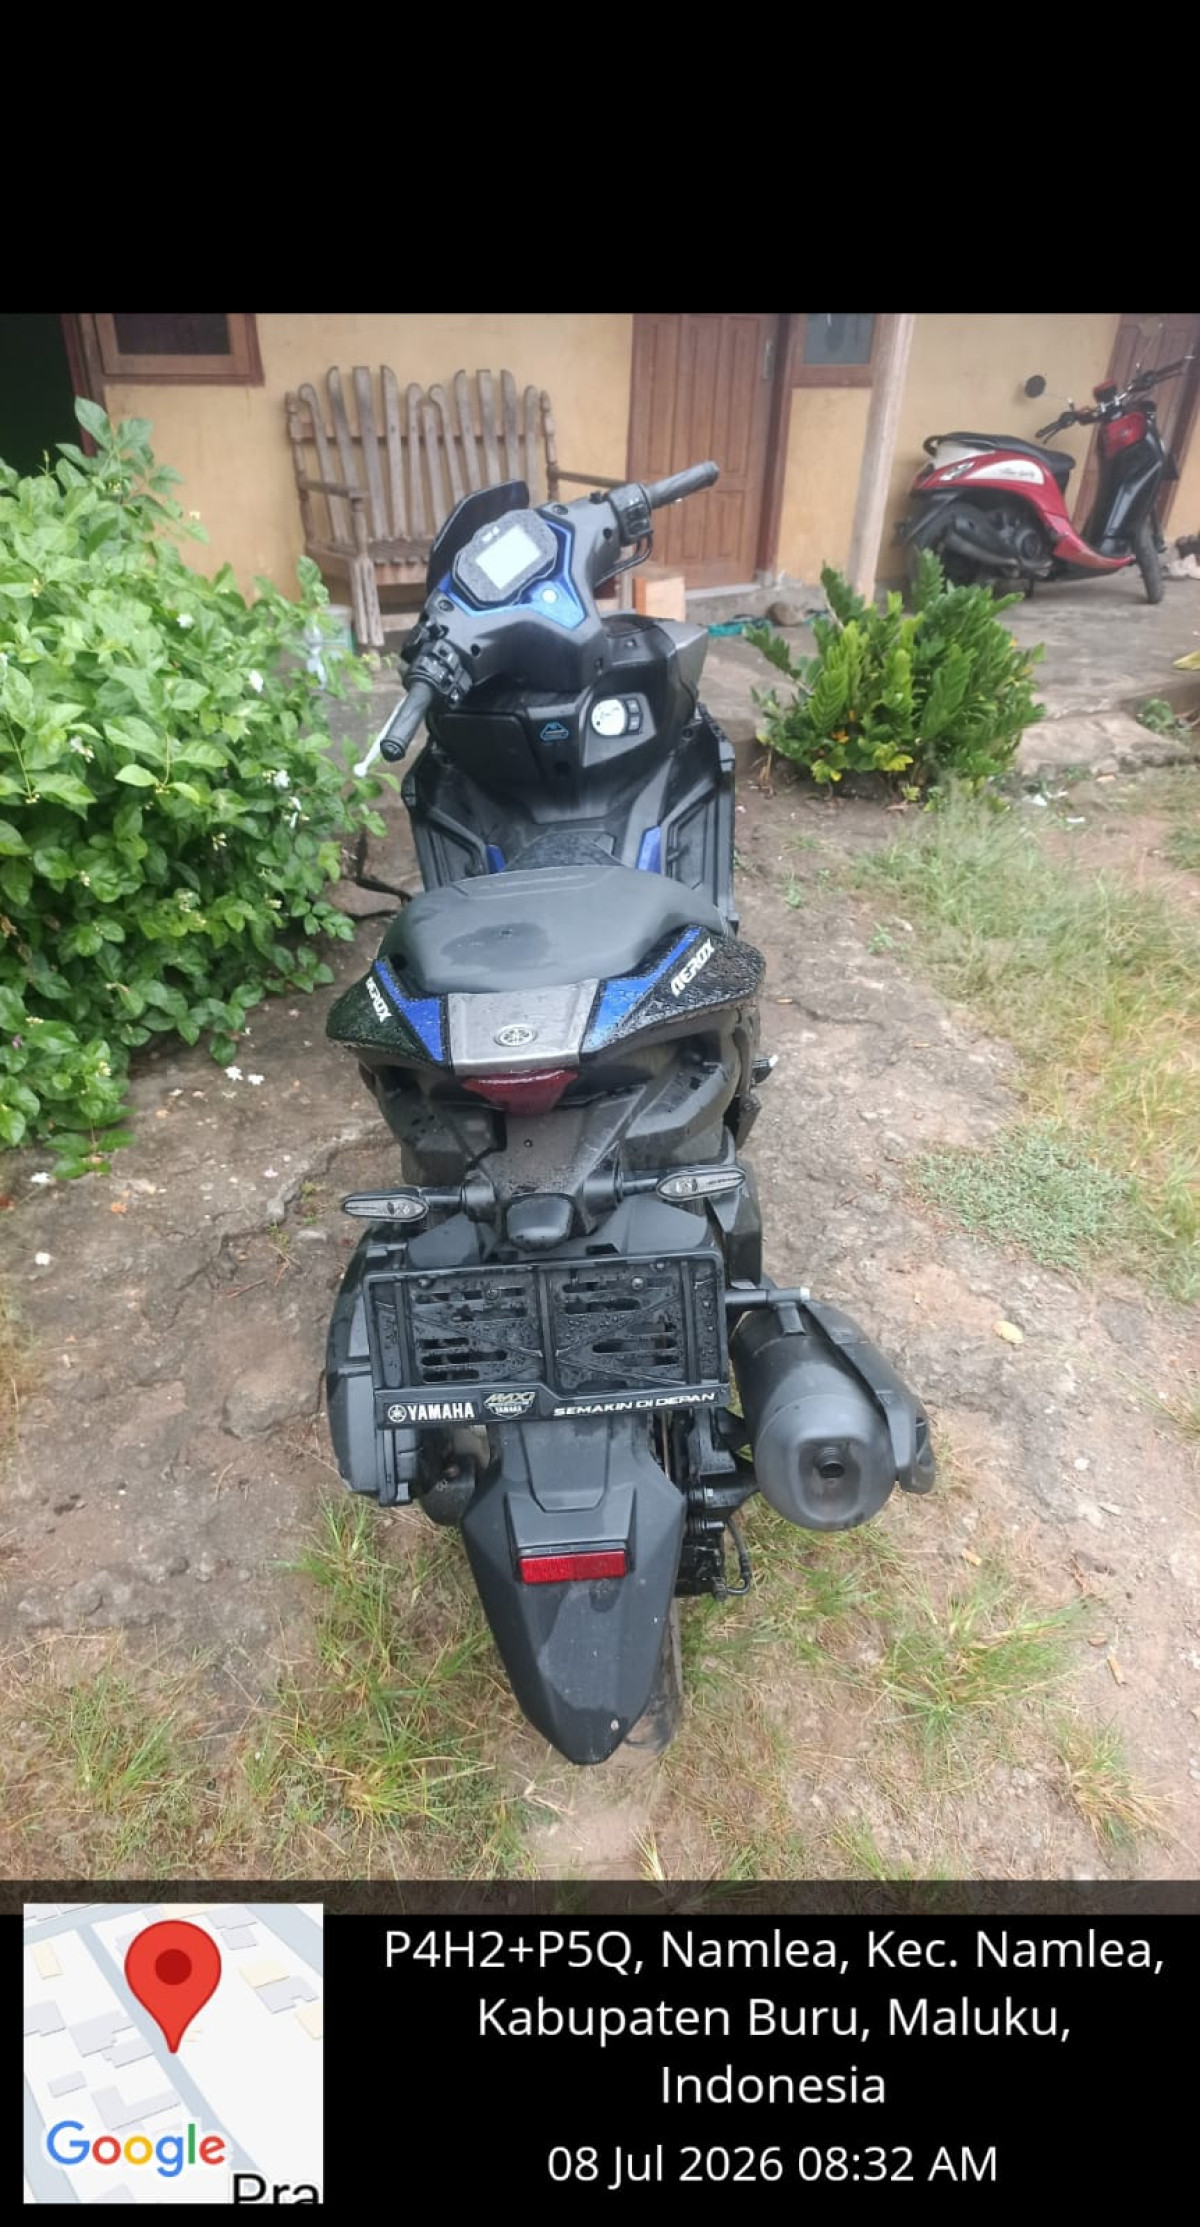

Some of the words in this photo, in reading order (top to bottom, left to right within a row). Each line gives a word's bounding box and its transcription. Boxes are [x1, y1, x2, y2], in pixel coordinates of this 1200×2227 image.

[670, 937, 715, 998] AEROX
[407, 1402, 476, 1421] YAMAHA
[553, 1402, 633, 1417] SEMAKIN
[635, 1399, 654, 1409] DI
[655, 1392, 716, 1407] DEPAN
